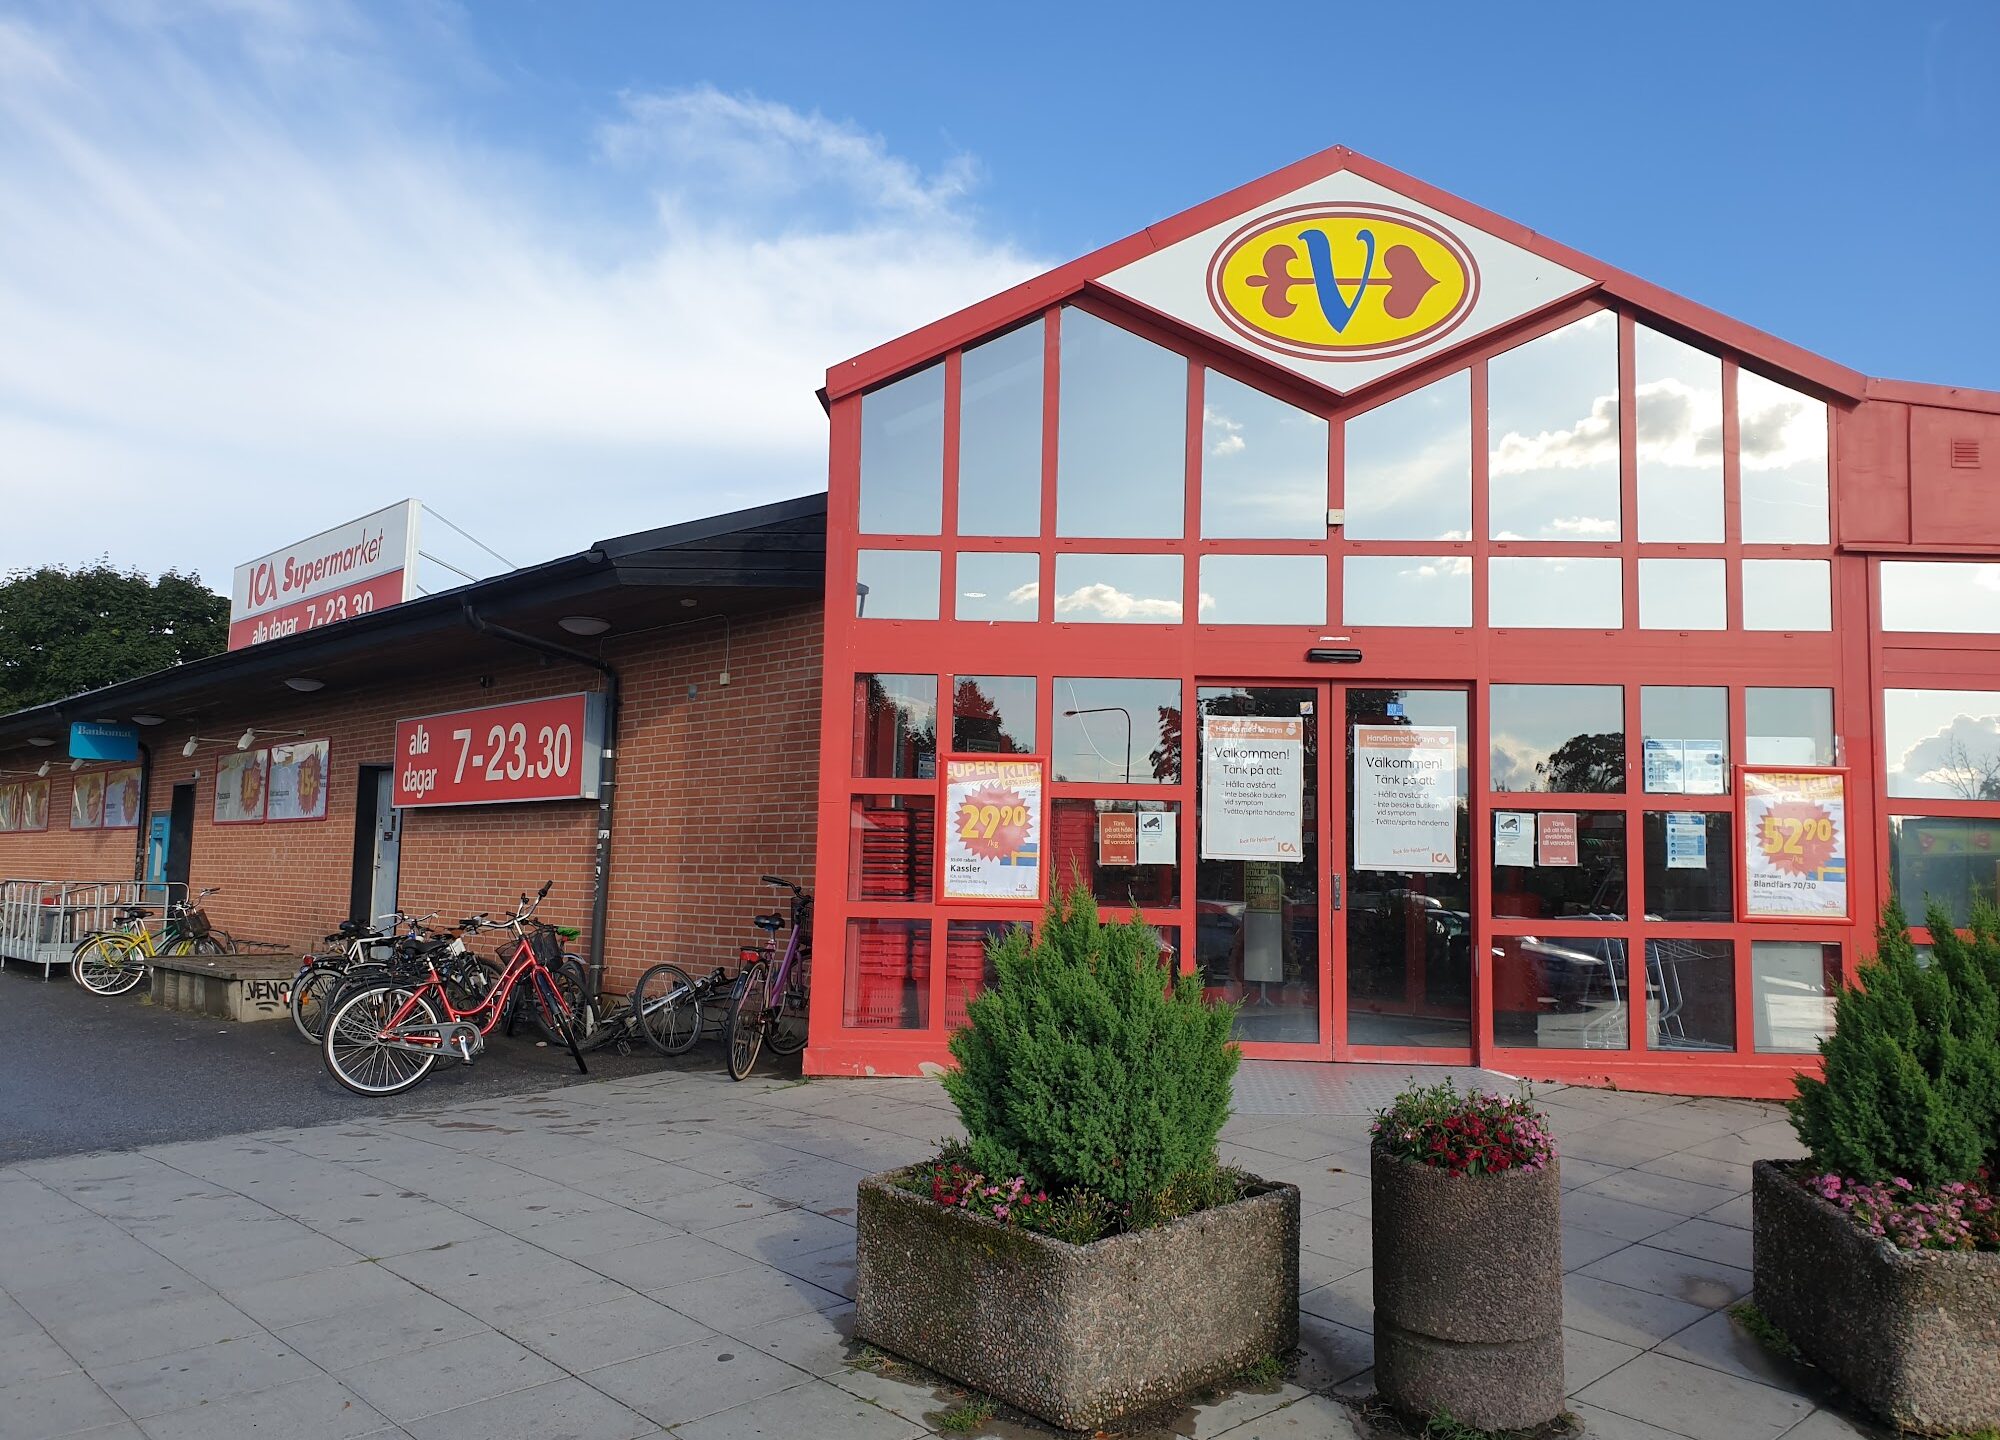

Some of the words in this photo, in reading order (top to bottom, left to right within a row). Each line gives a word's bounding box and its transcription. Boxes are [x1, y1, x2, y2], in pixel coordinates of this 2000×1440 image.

[247, 560, 278, 609] ICA
[283, 528, 384, 593] Supermarket
[252, 621, 268, 645] alla
[409, 724, 430, 755] alla
[453, 722, 572, 784] 7-23.30
[1214, 747, 1290, 760] Välkommen!
[1366, 757, 1443, 769] Välkommen!
[1223, 765, 1248, 774] Tänk
[1250, 765, 1264, 776] på
[1266, 767, 1283, 775] att:
[402, 762, 438, 799] dagar
[1375, 774, 1401, 784] Tänk
[1402, 775, 1417, 786] på
[1418, 777, 1436, 785] att:
[1278, 842, 1297, 852] ICA
[1431, 853, 1451, 863] ICA
[950, 864, 981, 873] Kassler
[1754, 880, 1792, 889] Blandfärs
[1793, 881, 1817, 890] 70/30
